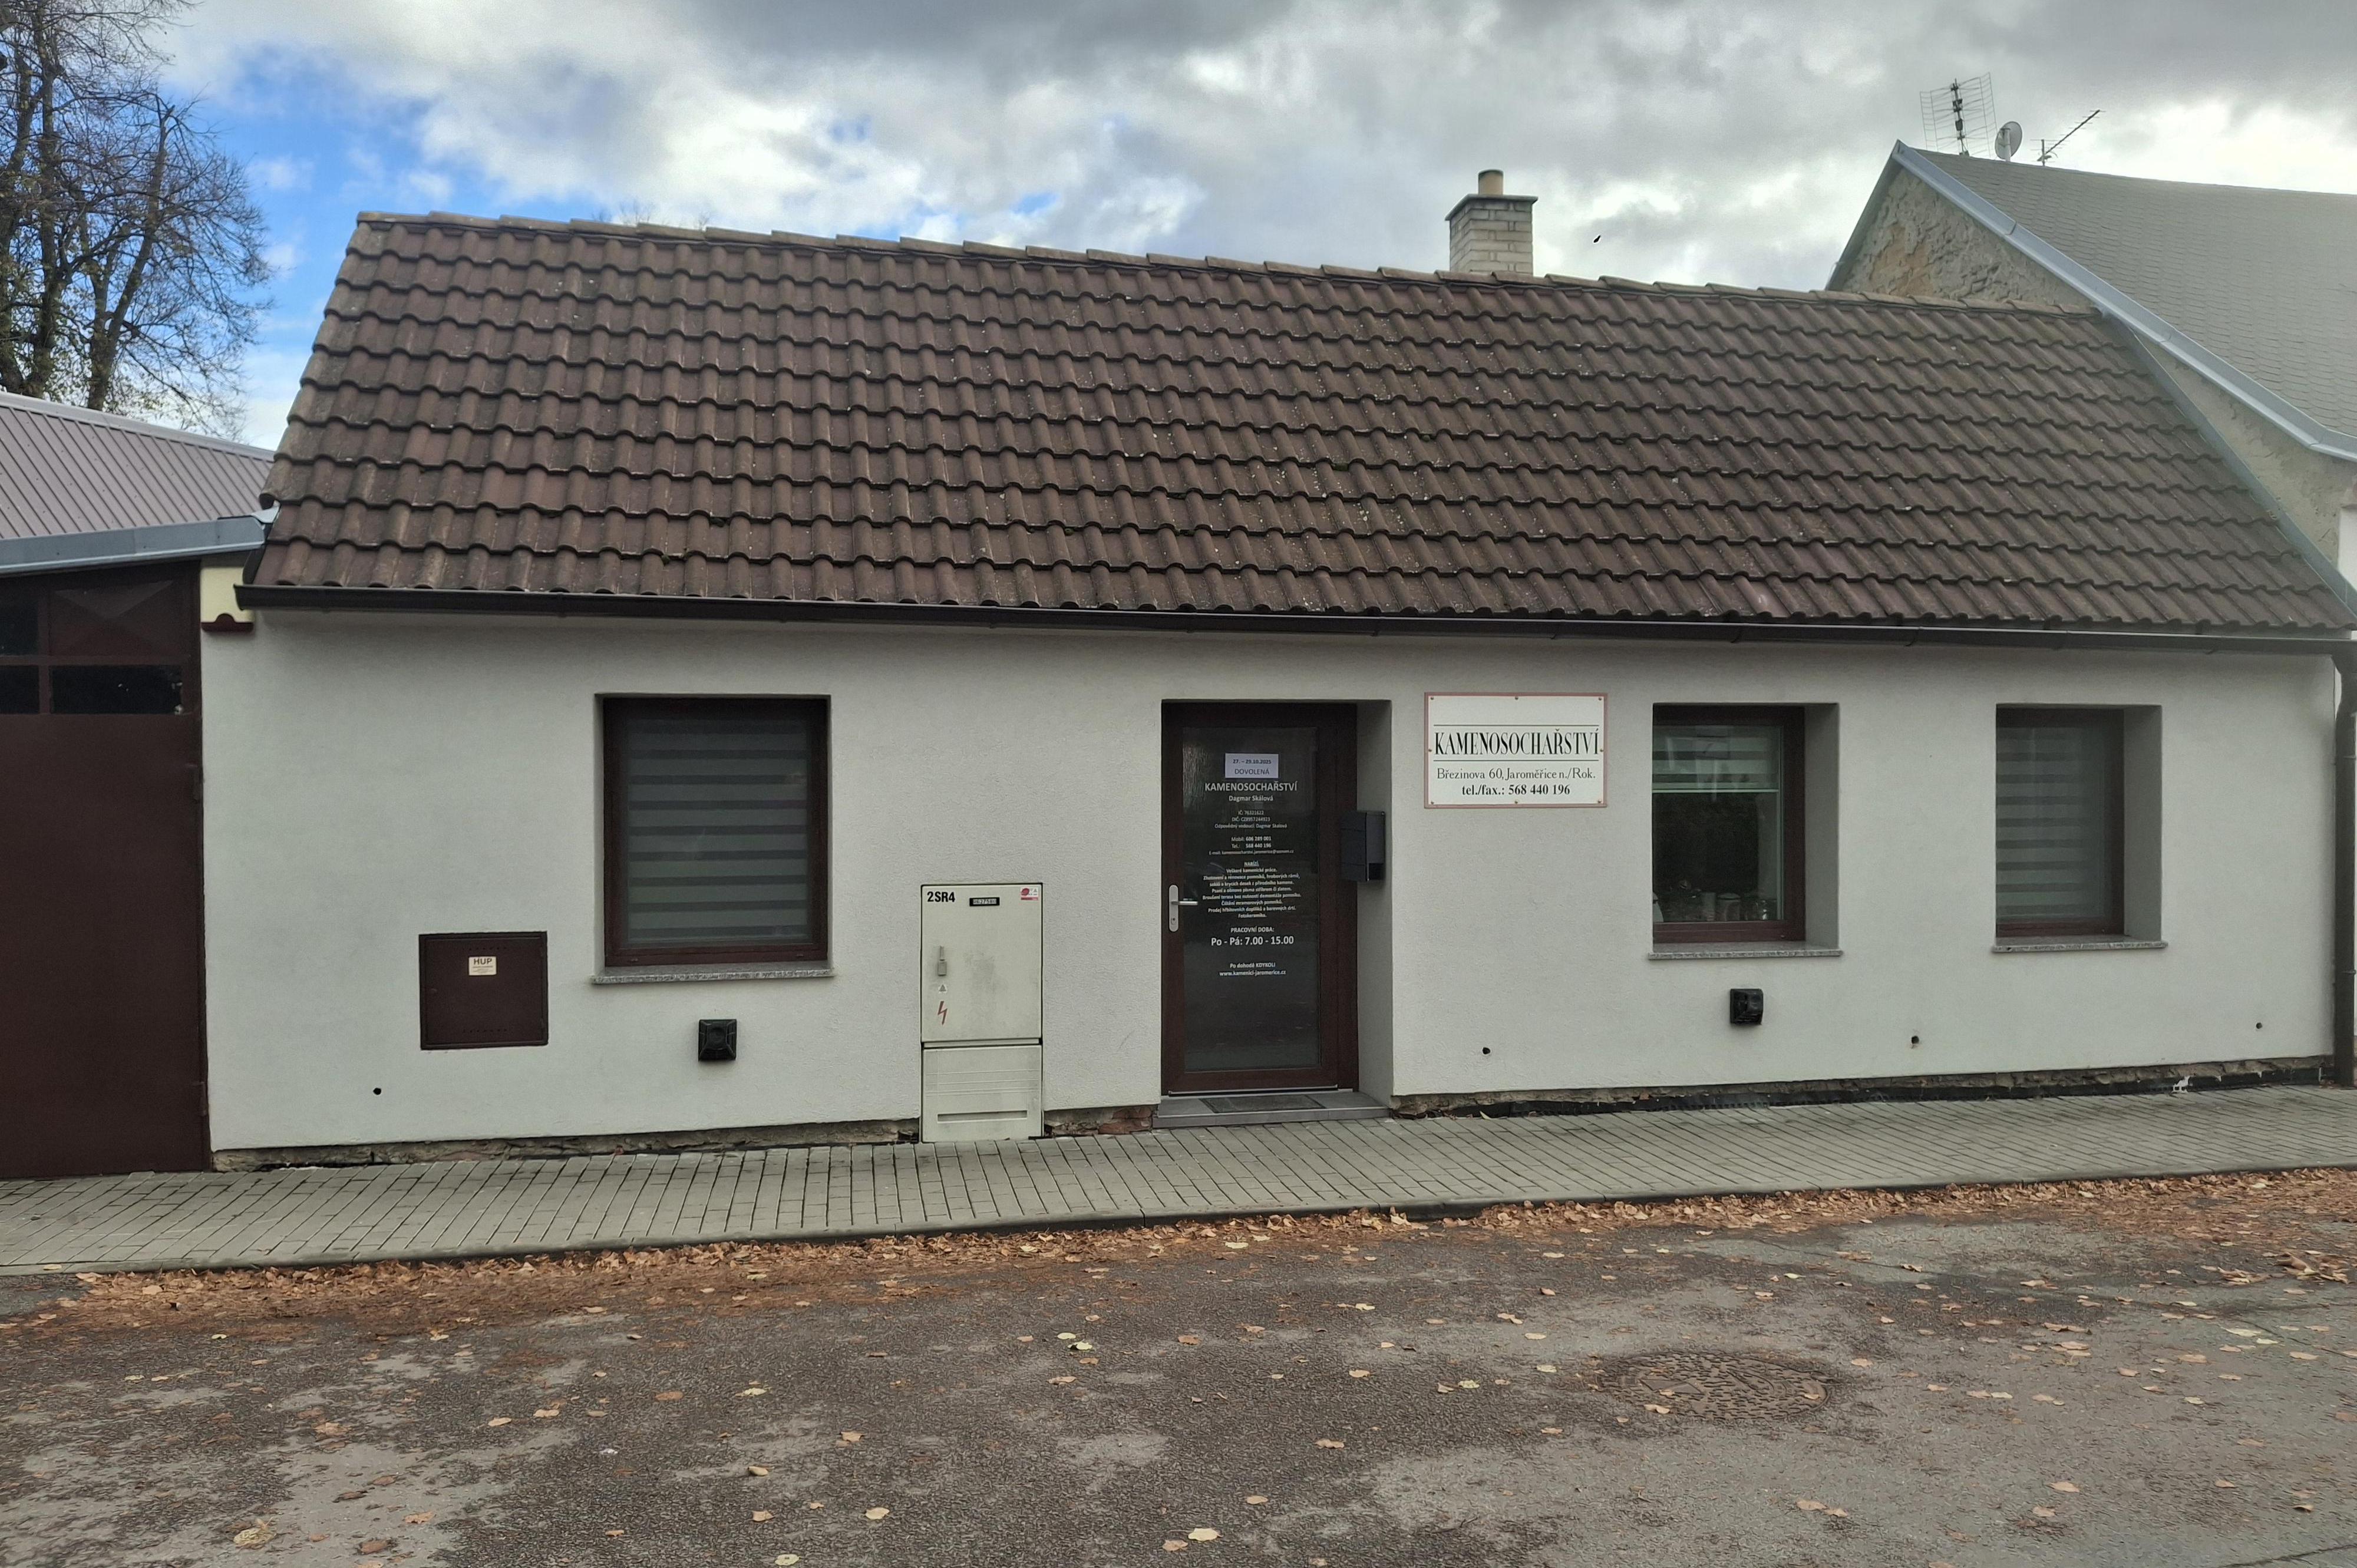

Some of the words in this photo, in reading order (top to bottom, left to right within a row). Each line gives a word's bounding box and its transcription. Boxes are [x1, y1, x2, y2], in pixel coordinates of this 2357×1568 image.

[1434, 728, 1599, 755] KAMENOSOCHAŘSTVÍ
[1437, 768, 1485, 779] Březinova
[1489, 768, 1504, 781] 60,
[1505, 768, 1557, 781] Jaroměřice
[1559, 768, 1596, 779] n./Rok.
[1205, 781, 1298, 791] KAMENOSOCHAŘSTVÍ
[1462, 785, 1504, 795] tel./fax.:
[1508, 785, 1526, 795] 568
[1530, 785, 1549, 795] 440
[1553, 785, 1570, 795] 196
[927, 892, 955, 902] 2SR4
[1211, 938, 1222, 946] Po
[1230, 937, 1243, 945] Pá:
[1271, 936, 1294, 945] 15.00
